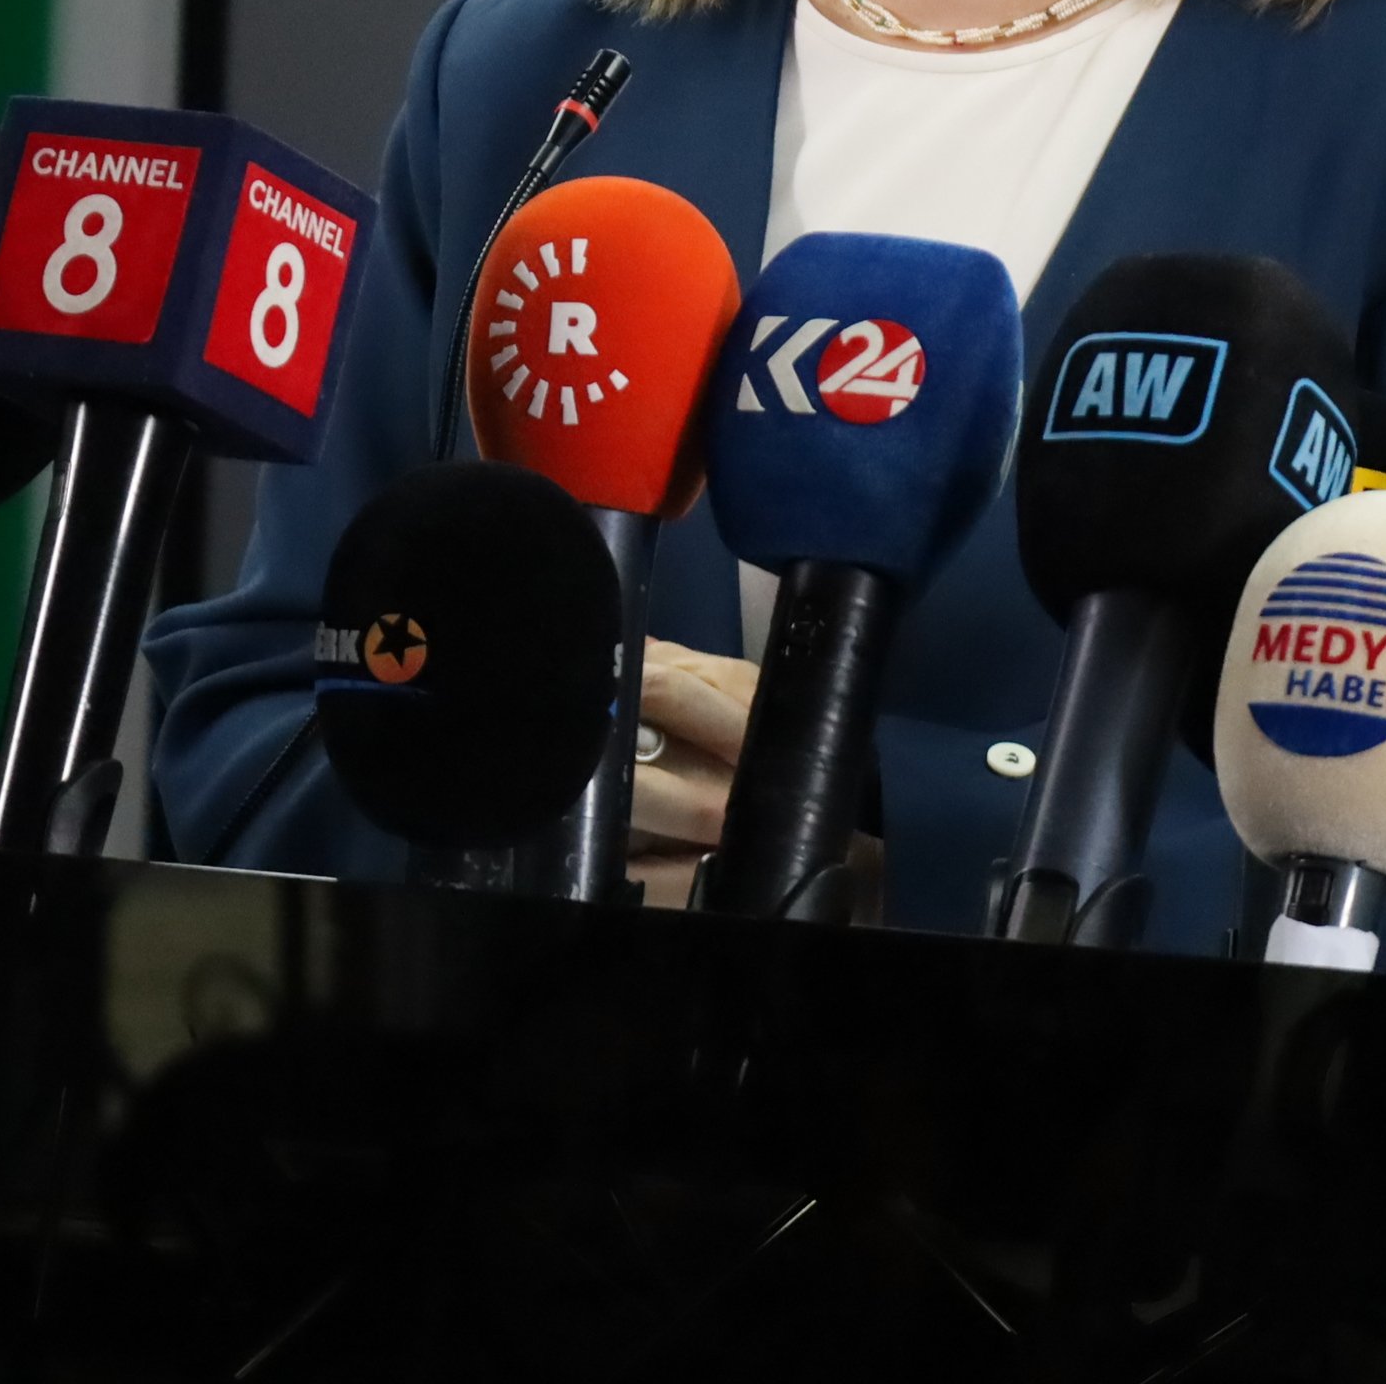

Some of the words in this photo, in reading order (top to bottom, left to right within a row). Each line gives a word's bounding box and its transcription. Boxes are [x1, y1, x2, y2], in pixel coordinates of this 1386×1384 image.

[32, 147, 184, 190] CHANNEL
[42, 193, 124, 314] 8
[249, 179, 345, 259] CHANNEL
[250, 242, 305, 369] 8
[548, 302, 599, 355] R
[1072, 352, 1195, 421] AW
[1292, 410, 1352, 502] AW
